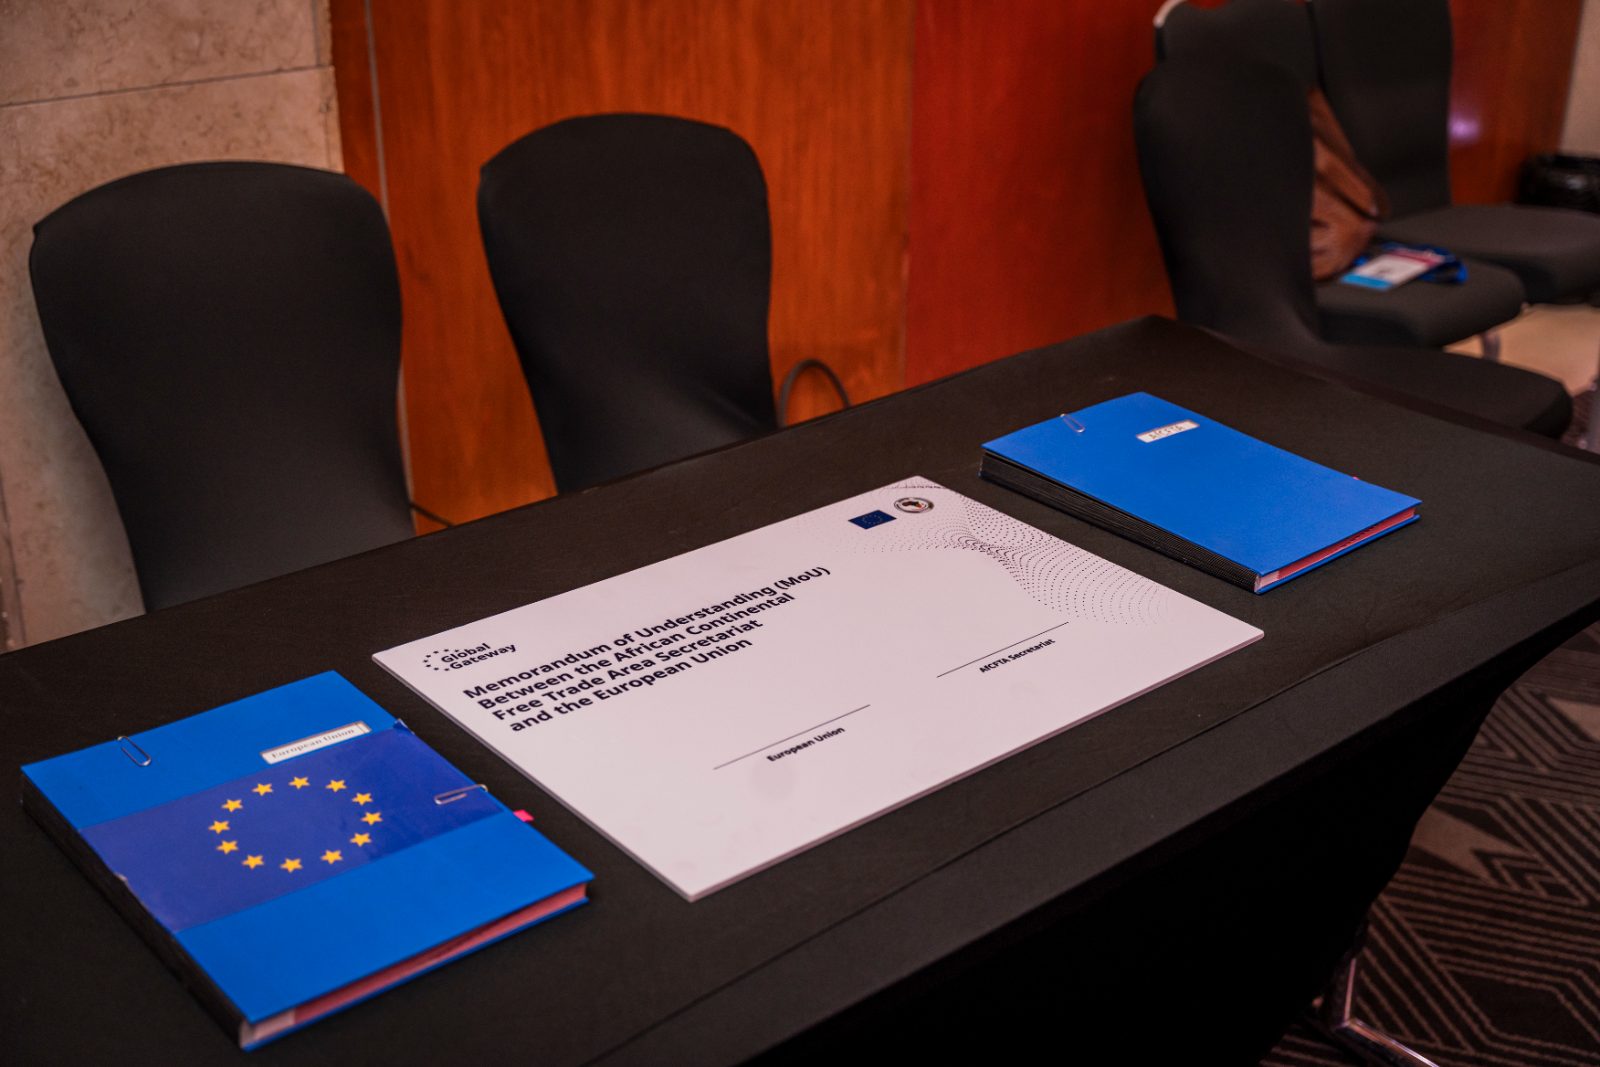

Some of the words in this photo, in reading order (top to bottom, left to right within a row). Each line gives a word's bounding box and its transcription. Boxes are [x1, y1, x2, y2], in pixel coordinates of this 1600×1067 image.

[463, 643, 611, 699] Memorandum
[613, 633, 635, 648] of
[635, 587, 777, 639] Understanding
[774, 567, 831, 590] (MoU)
[441, 643, 491, 662] Global
[450, 645, 516, 669] Gateway
[477, 672, 574, 710] Between
[574, 658, 612, 676] the
[614, 634, 687, 662] African
[685, 593, 796, 635] Continental
[979, 658, 1011, 672] AfCFTA
[1008, 639, 1055, 660] Secretariat
[491, 698, 542, 721] Free
[542, 677, 605, 702] Trade
[607, 659, 656, 681] Area
[651, 619, 763, 662] Secretariat
[509, 711, 554, 732] and
[554, 696, 593, 714] the
[593, 661, 692, 700] European
[689, 639, 752, 664] Union
[272, 739, 322, 758] European
[323, 729, 355, 741] Union
[766, 740, 815, 761] European
[814, 727, 845, 741] Union
